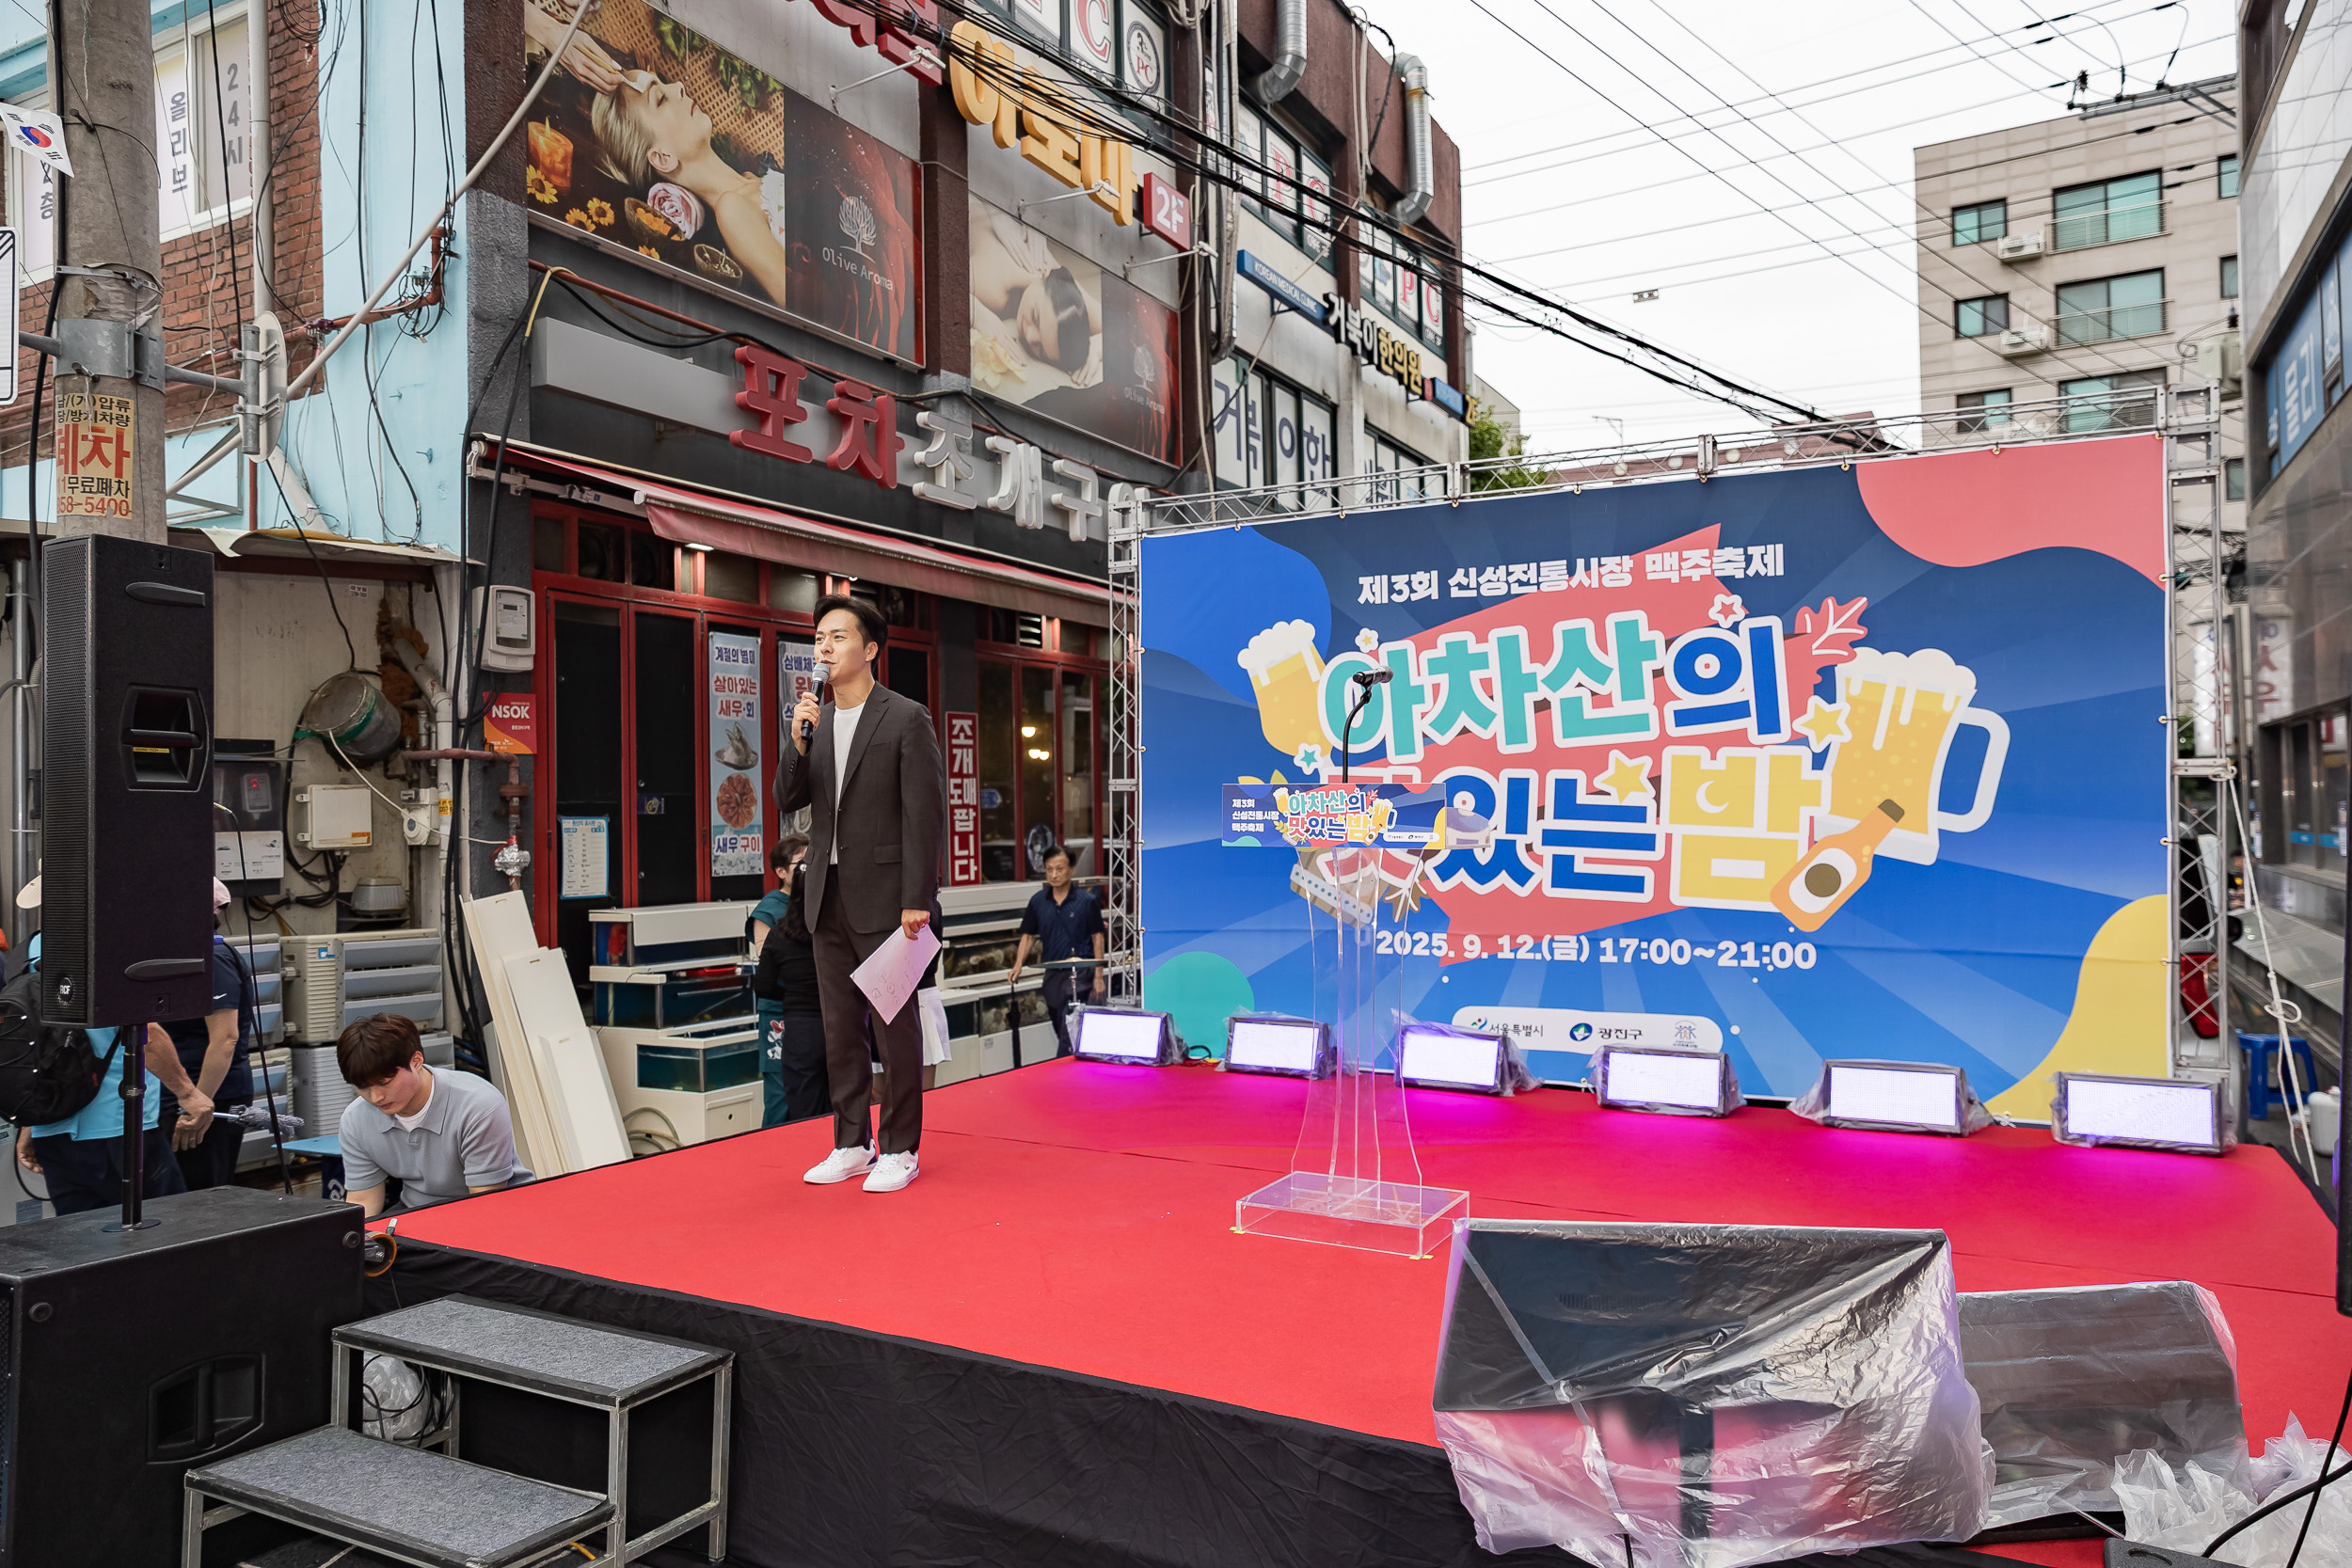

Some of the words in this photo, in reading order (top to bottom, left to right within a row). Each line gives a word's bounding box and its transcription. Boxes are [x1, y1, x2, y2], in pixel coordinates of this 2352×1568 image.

[950, 19, 1136, 226] 아로마
[170, 91, 189, 194] 올리브
[1155, 185, 1184, 234] 2F
[822, 246, 858, 275] Olive
[860, 264, 894, 292] Aroma
[1327, 293, 1423, 396] 거북이한의원
[730, 345, 905, 490] 포차
[68, 476, 130, 499] 무료폐차
[1357, 571, 1440, 606] 제3회
[1447, 555, 1635, 599] 신성전통시장
[1645, 543, 1786, 585] 맥주축제
[715, 646, 739, 663] 계절의
[714, 675, 757, 695] 살아있는
[1321, 617, 1784, 760] 아차산의
[492, 705, 531, 720] NSOK
[1232, 799, 1255, 809] 제3회
[1232, 811, 1280, 821] 신성전통시장
[1288, 788, 1367, 816] 아차산의
[1232, 823, 1265, 832] 맥주축제
[1288, 816, 1347, 840] 맛있는
[1347, 813, 1371, 842] 밤
[1663, 747, 1831, 911] 밤
[715, 837, 738, 853] 새우
[740, 836, 760, 852] 구이
[1375, 929, 1455, 958] 2025.
[1462, 934, 1487, 958] 9.
[1599, 937, 1818, 971] 17:00~21:00
[1489, 1022, 1544, 1037] 서울특별시
[1597, 1027, 1644, 1040] 광진구
